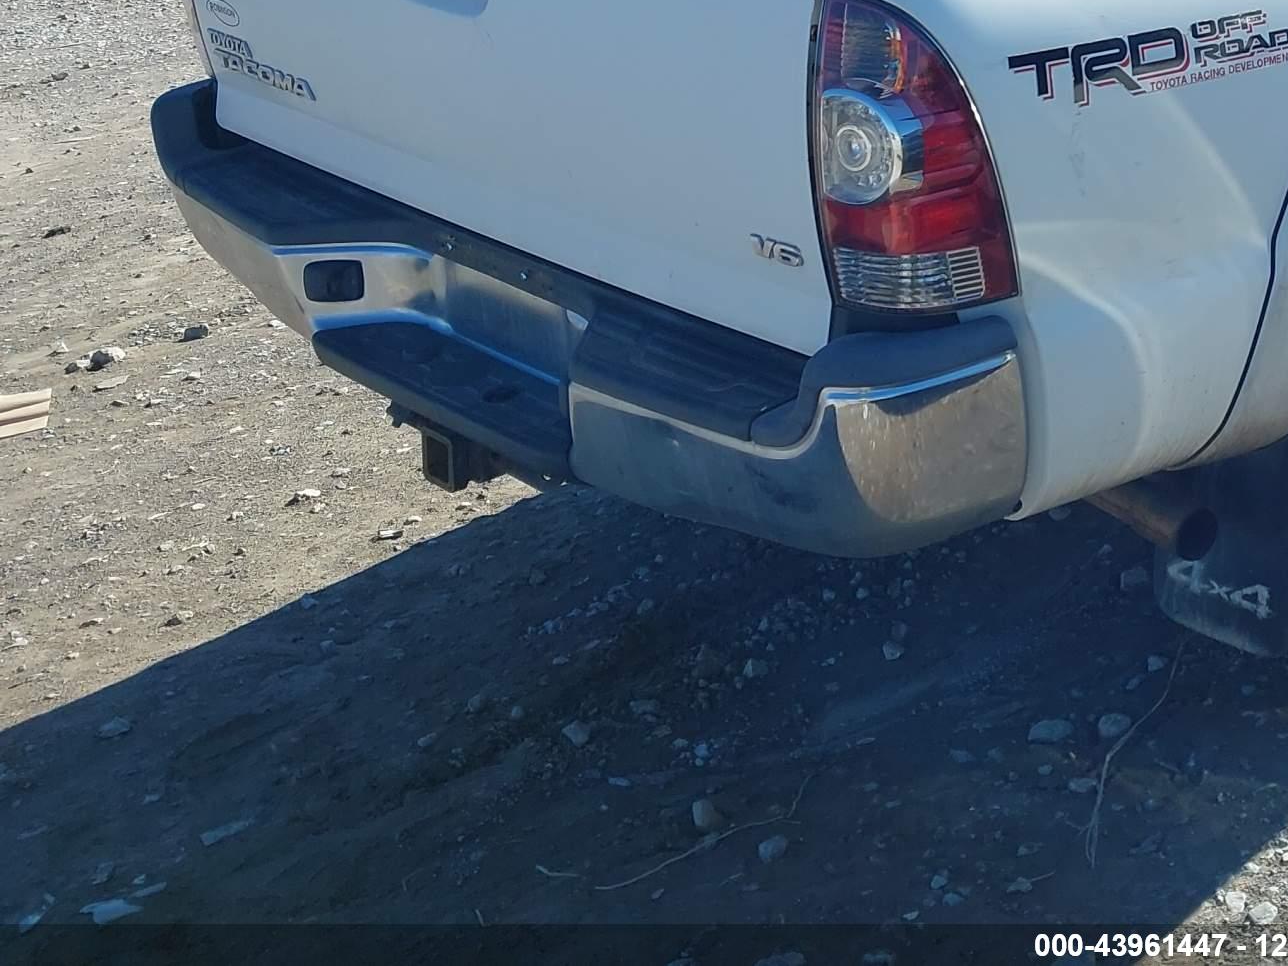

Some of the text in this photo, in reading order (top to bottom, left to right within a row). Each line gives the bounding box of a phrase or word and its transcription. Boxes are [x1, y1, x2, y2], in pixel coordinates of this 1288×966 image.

[1189, 9, 1267, 42] OFF
[207, 27, 253, 59] TOYOTA
[213, 47, 317, 101] TACOMA
[1007, 26, 1191, 108] TRD
[1150, 73, 1188, 92] TOYOTA
[1190, 67, 1226, 84] RACING
[750, 233, 804, 267] V6
